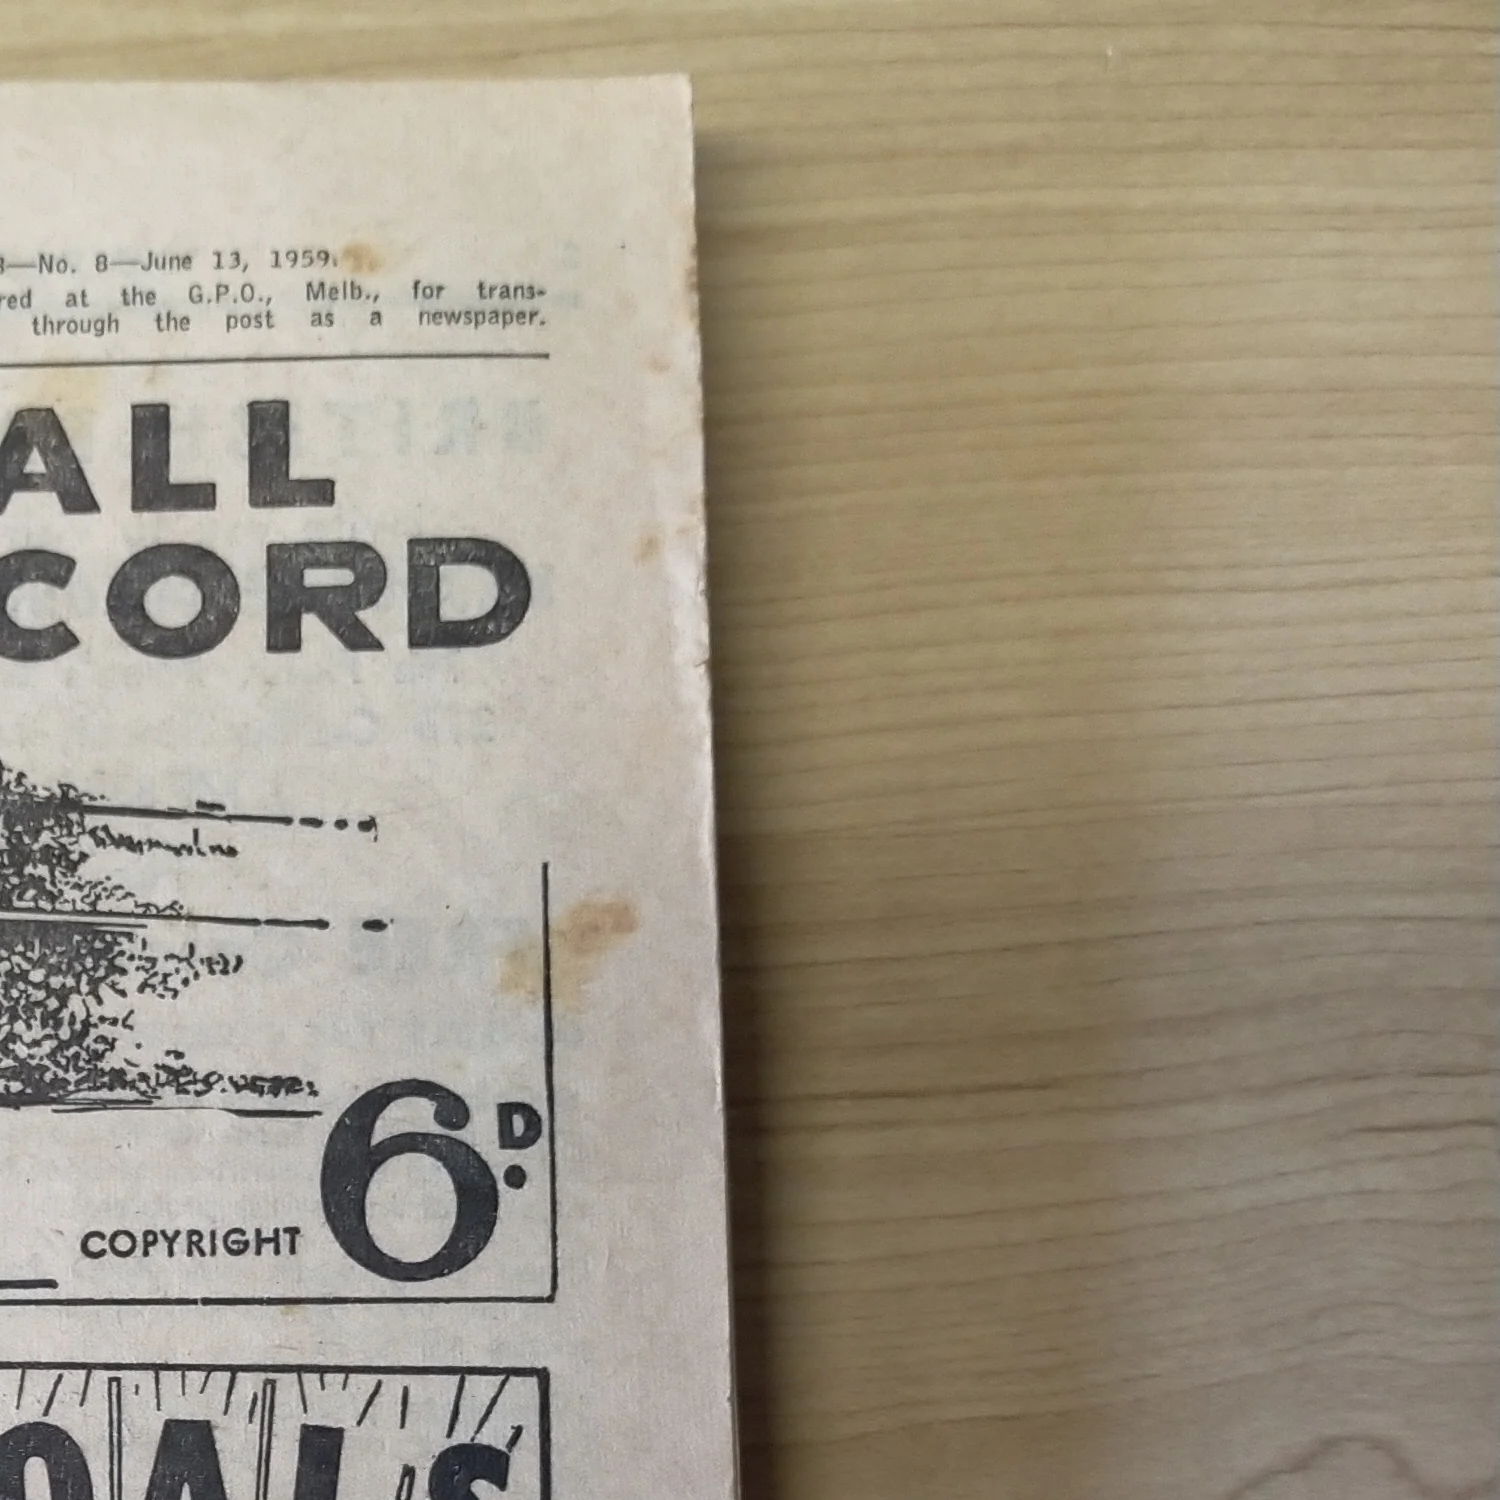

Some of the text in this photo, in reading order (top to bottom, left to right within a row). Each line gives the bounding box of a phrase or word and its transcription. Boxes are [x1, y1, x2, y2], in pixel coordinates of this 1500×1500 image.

[212, 250, 249, 273] 13,
[271, 249, 338, 269] 1959.
[65, 288, 90, 308] at
[120, 285, 157, 307] the
[188, 282, 273, 307] G.P.O.,
[305, 279, 380, 304] Melb.,
[412, 279, 446, 300] for
[477, 281, 547, 301] trans-
[31, 311, 120, 338] through
[154, 309, 191, 333] the
[225, 309, 275, 334] post
[310, 311, 334, 328] as
[369, 310, 382, 326] a
[418, 308, 546, 330] newspaper.
[80, 1226, 301, 1260] COPYRIGHT
